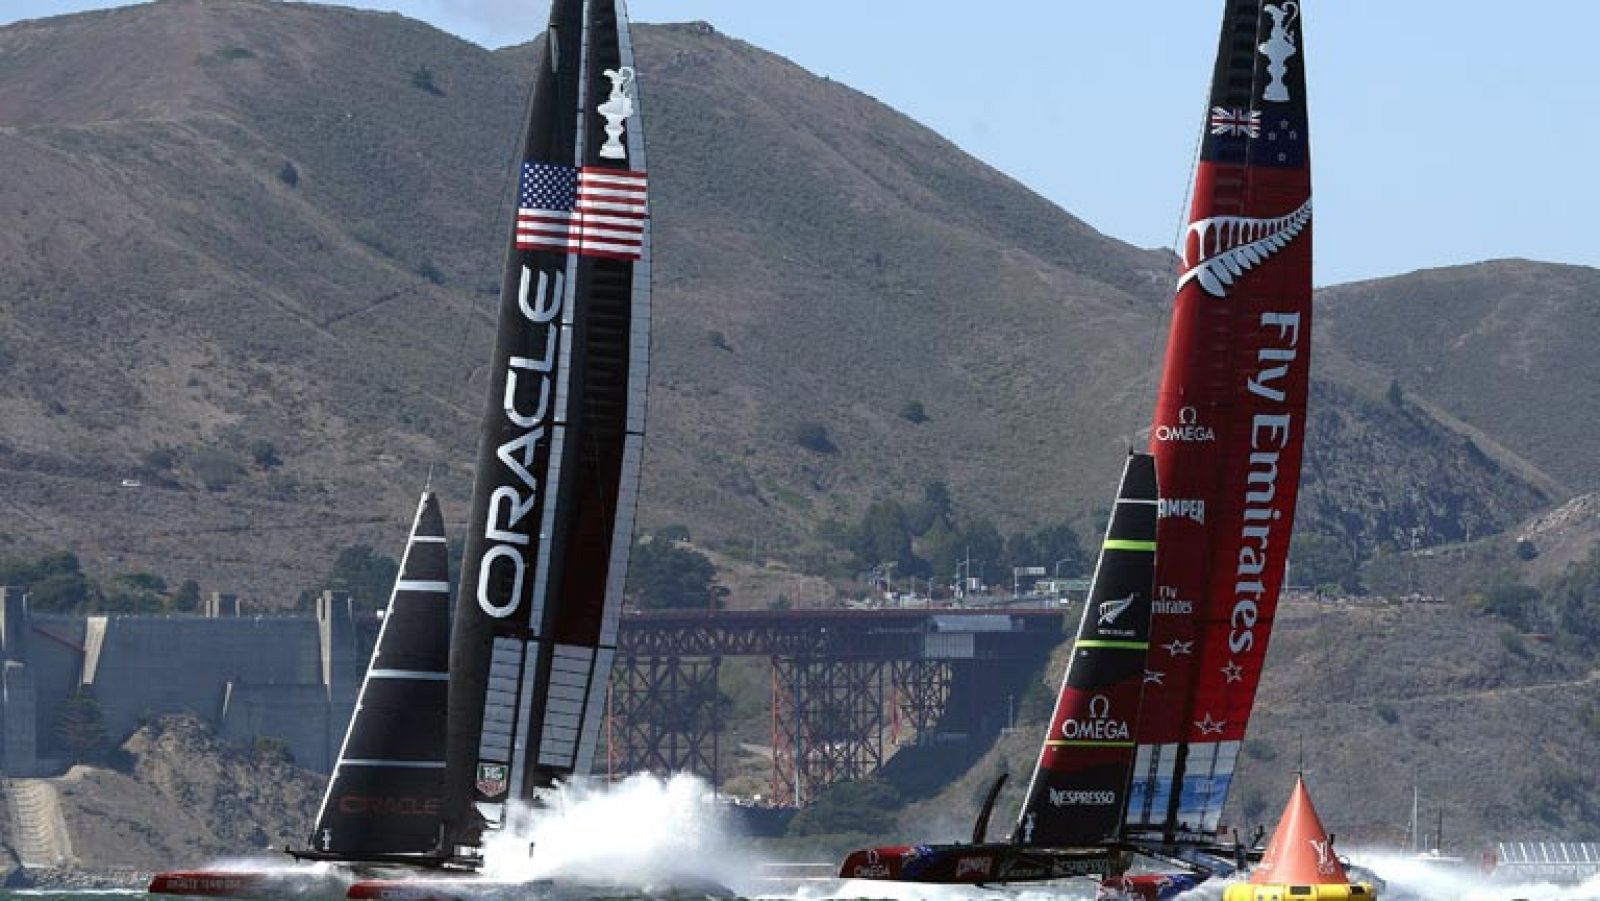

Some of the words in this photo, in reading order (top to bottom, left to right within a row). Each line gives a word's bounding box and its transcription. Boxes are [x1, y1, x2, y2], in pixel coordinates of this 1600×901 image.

[1247, 312, 1301, 402] Fly
[477, 264, 564, 617] ORACLE
[1156, 425, 1216, 441] OMEGA
[1157, 498, 1205, 525] AMPER
[1228, 413, 1291, 655] Emirates
[1062, 719, 1131, 739] OMEGA
